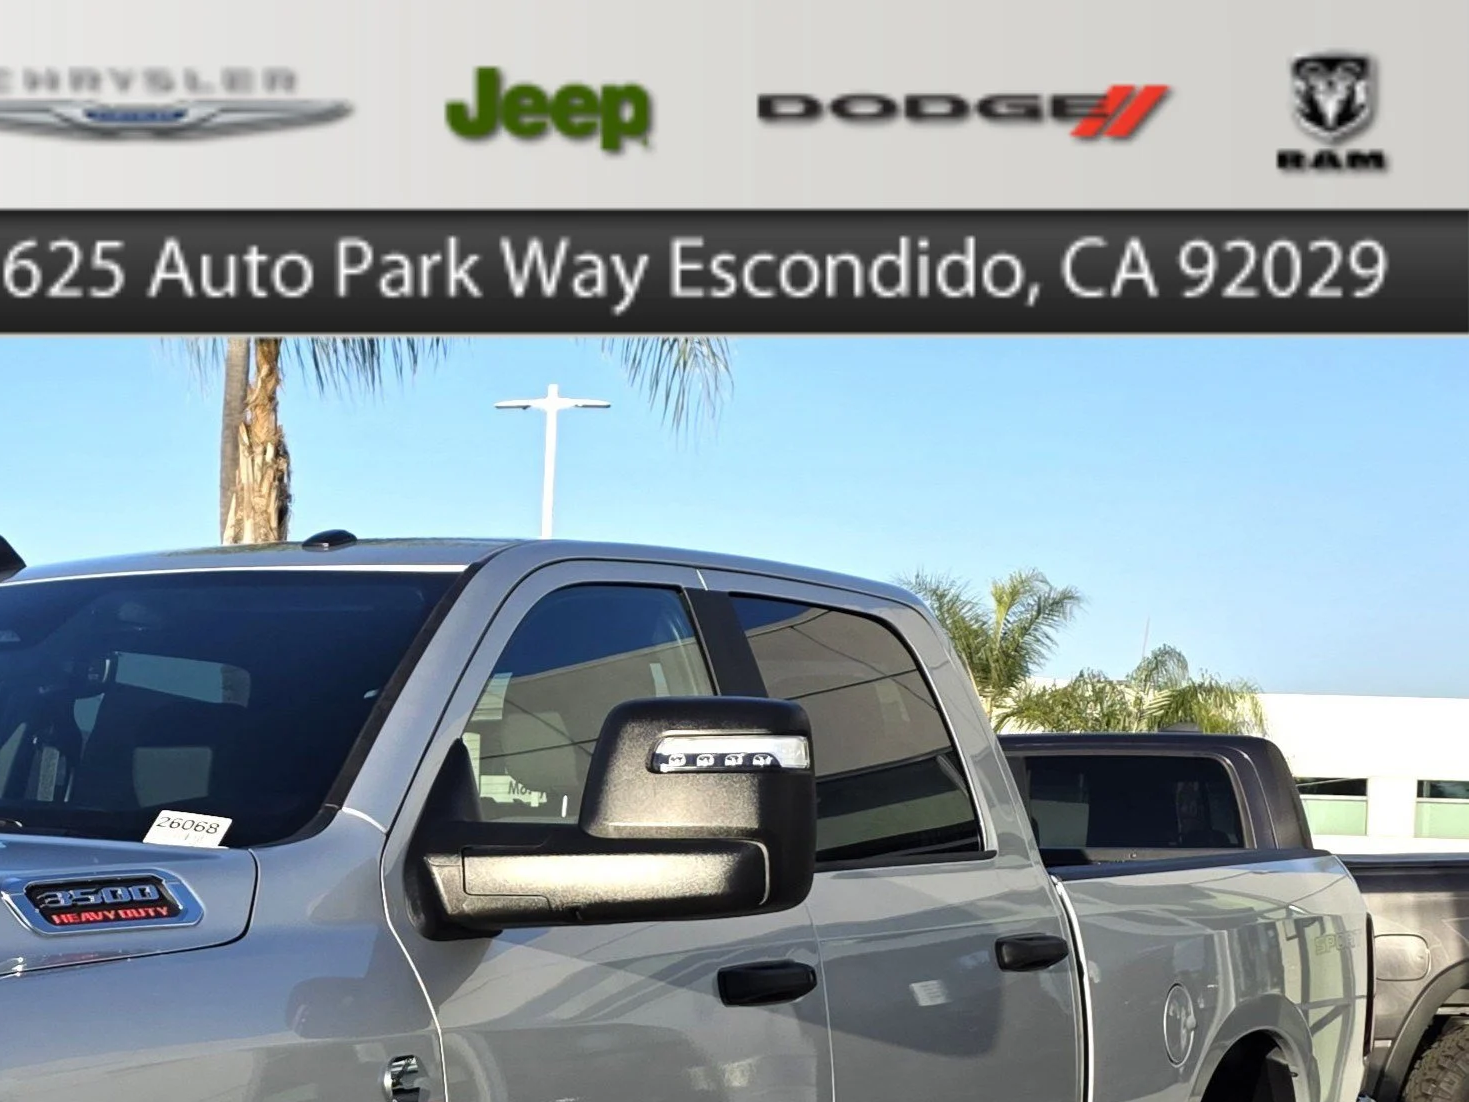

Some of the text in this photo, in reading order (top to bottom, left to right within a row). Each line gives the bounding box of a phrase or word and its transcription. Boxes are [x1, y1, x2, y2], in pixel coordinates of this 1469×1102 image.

[156, 815, 221, 836] 26068
[36, 883, 161, 909] 3500
[50, 905, 170, 926] HEAVY DUTY
